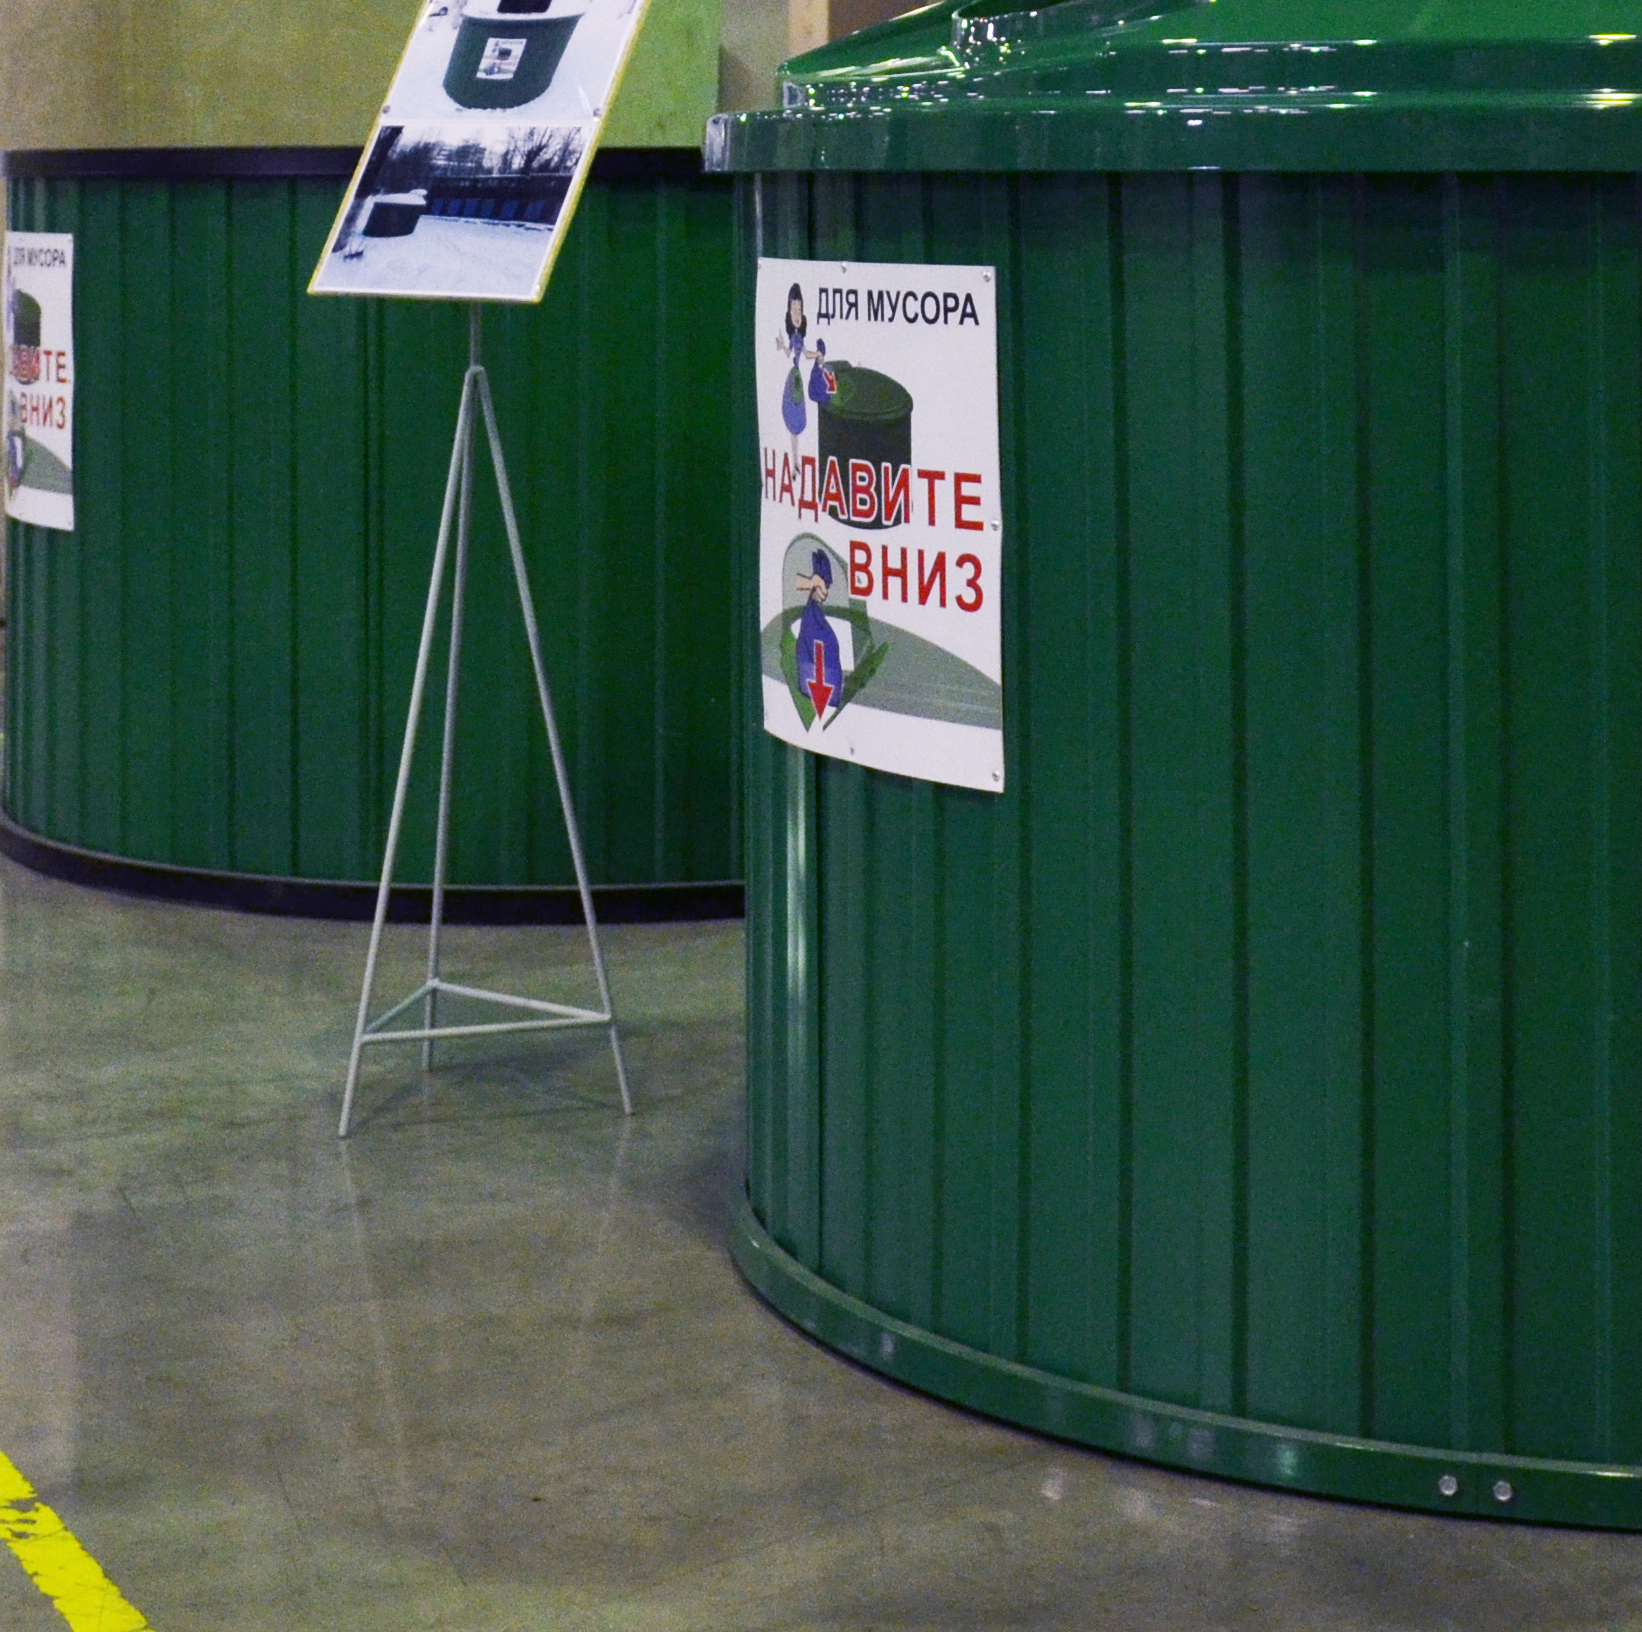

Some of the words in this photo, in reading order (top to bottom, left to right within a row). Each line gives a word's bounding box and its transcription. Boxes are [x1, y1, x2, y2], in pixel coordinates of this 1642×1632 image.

[816, 287, 859, 325] ДЛЯ
[866, 289, 980, 327] МУСОРА
[20, 392, 67, 430] ВНИЗ
[764, 447, 985, 532] НАДАВИТЕ
[848, 538, 985, 614] ВНИЗ
